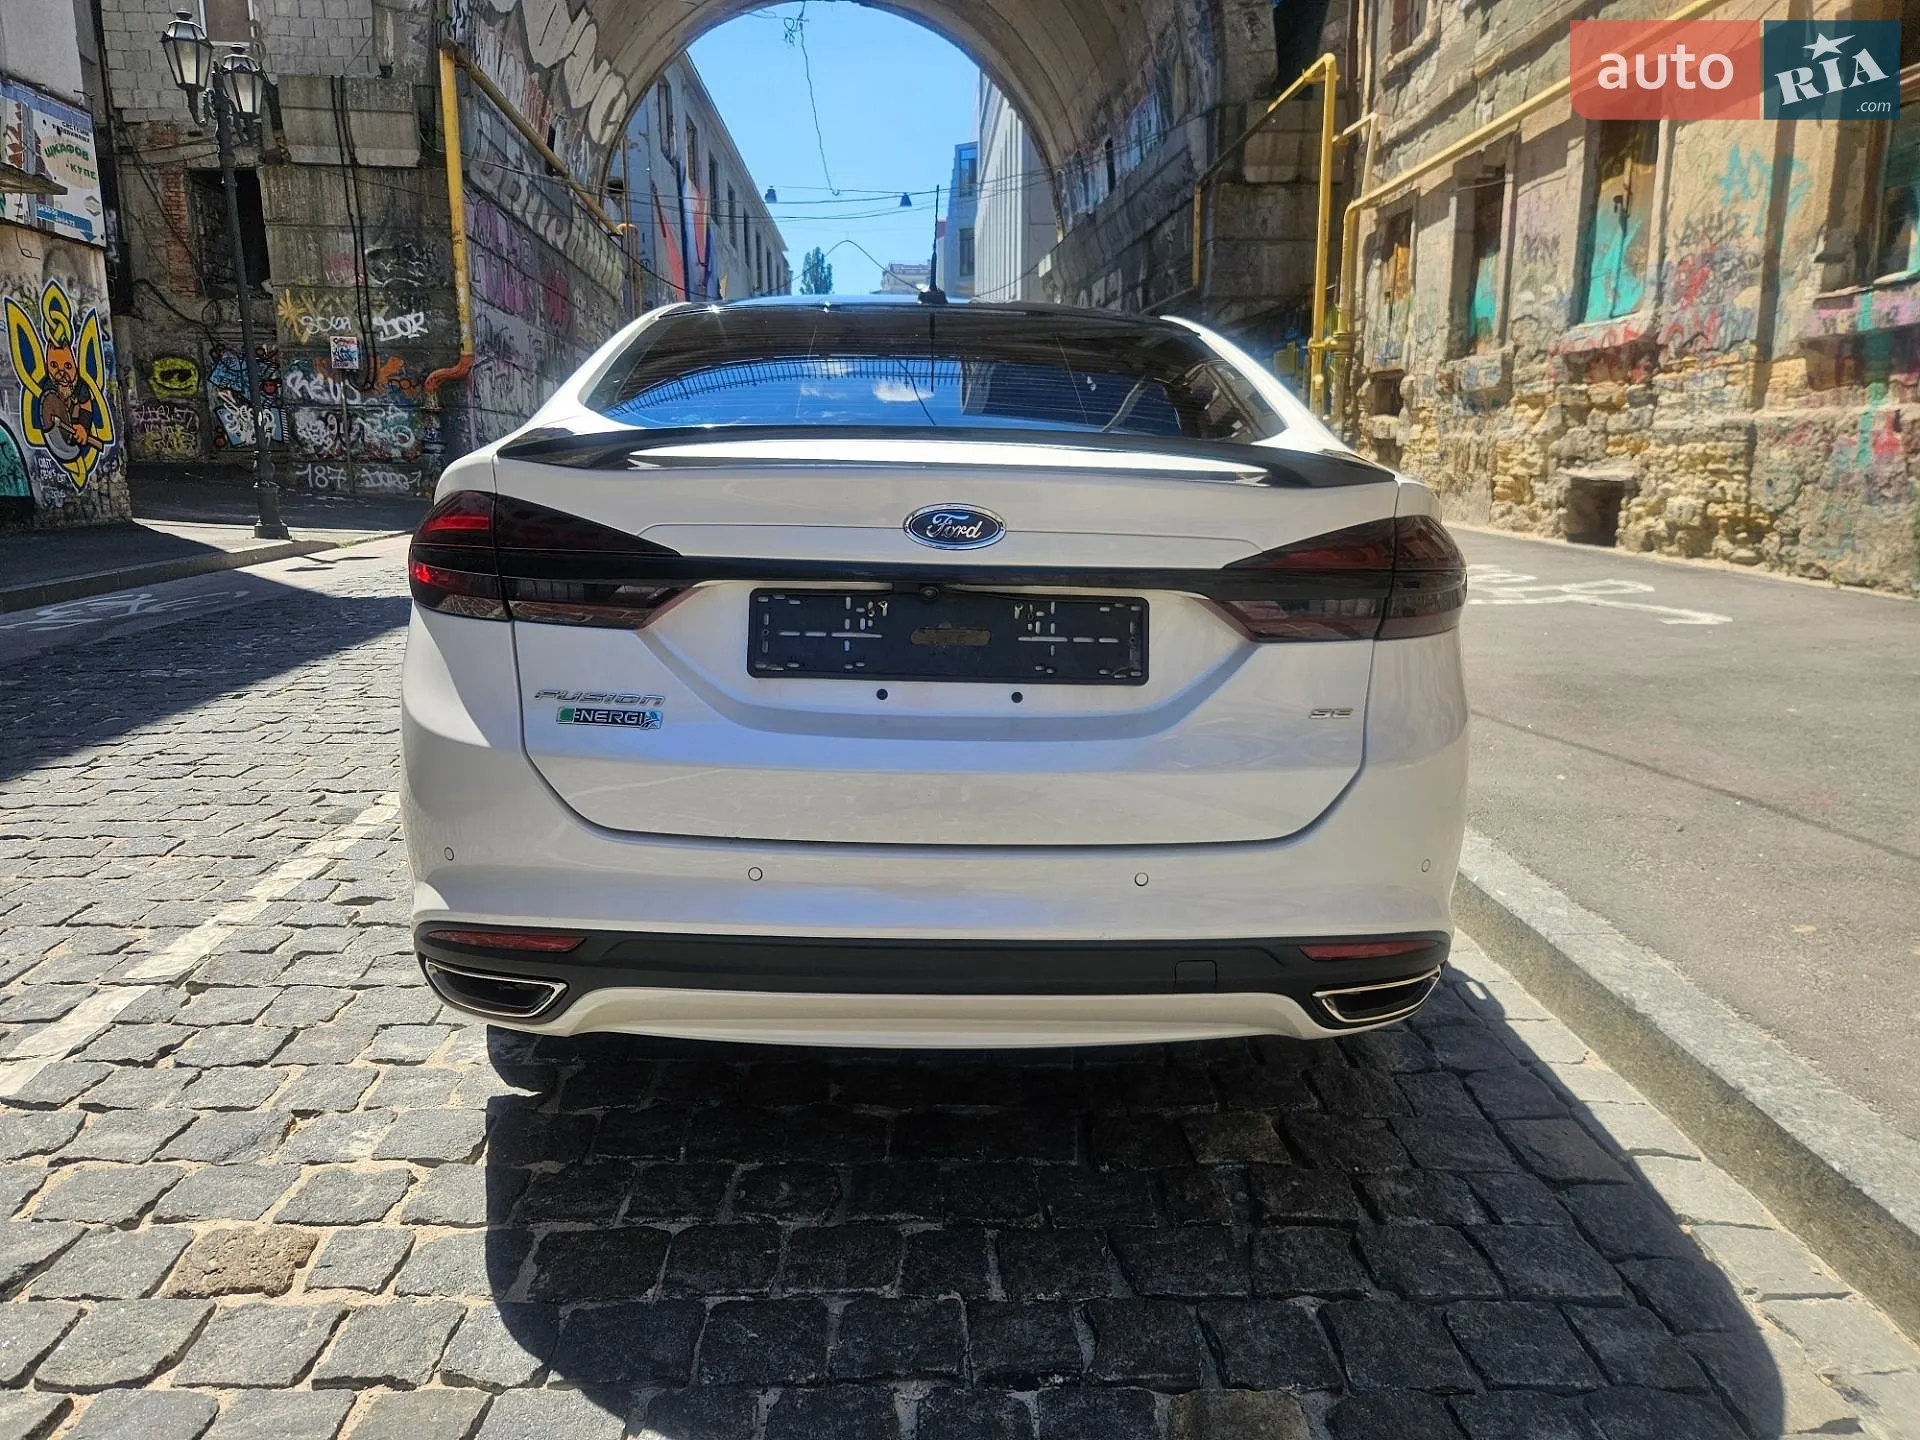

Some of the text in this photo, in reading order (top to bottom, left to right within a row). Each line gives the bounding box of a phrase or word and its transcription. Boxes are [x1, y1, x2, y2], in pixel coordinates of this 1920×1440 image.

[44, 143, 89, 161] ШКАФОВ
[296, 463, 347, 488] 187
[926, 513, 983, 538] Ford
[534, 688, 666, 706] FUSION
[1309, 708, 1353, 720] SE
